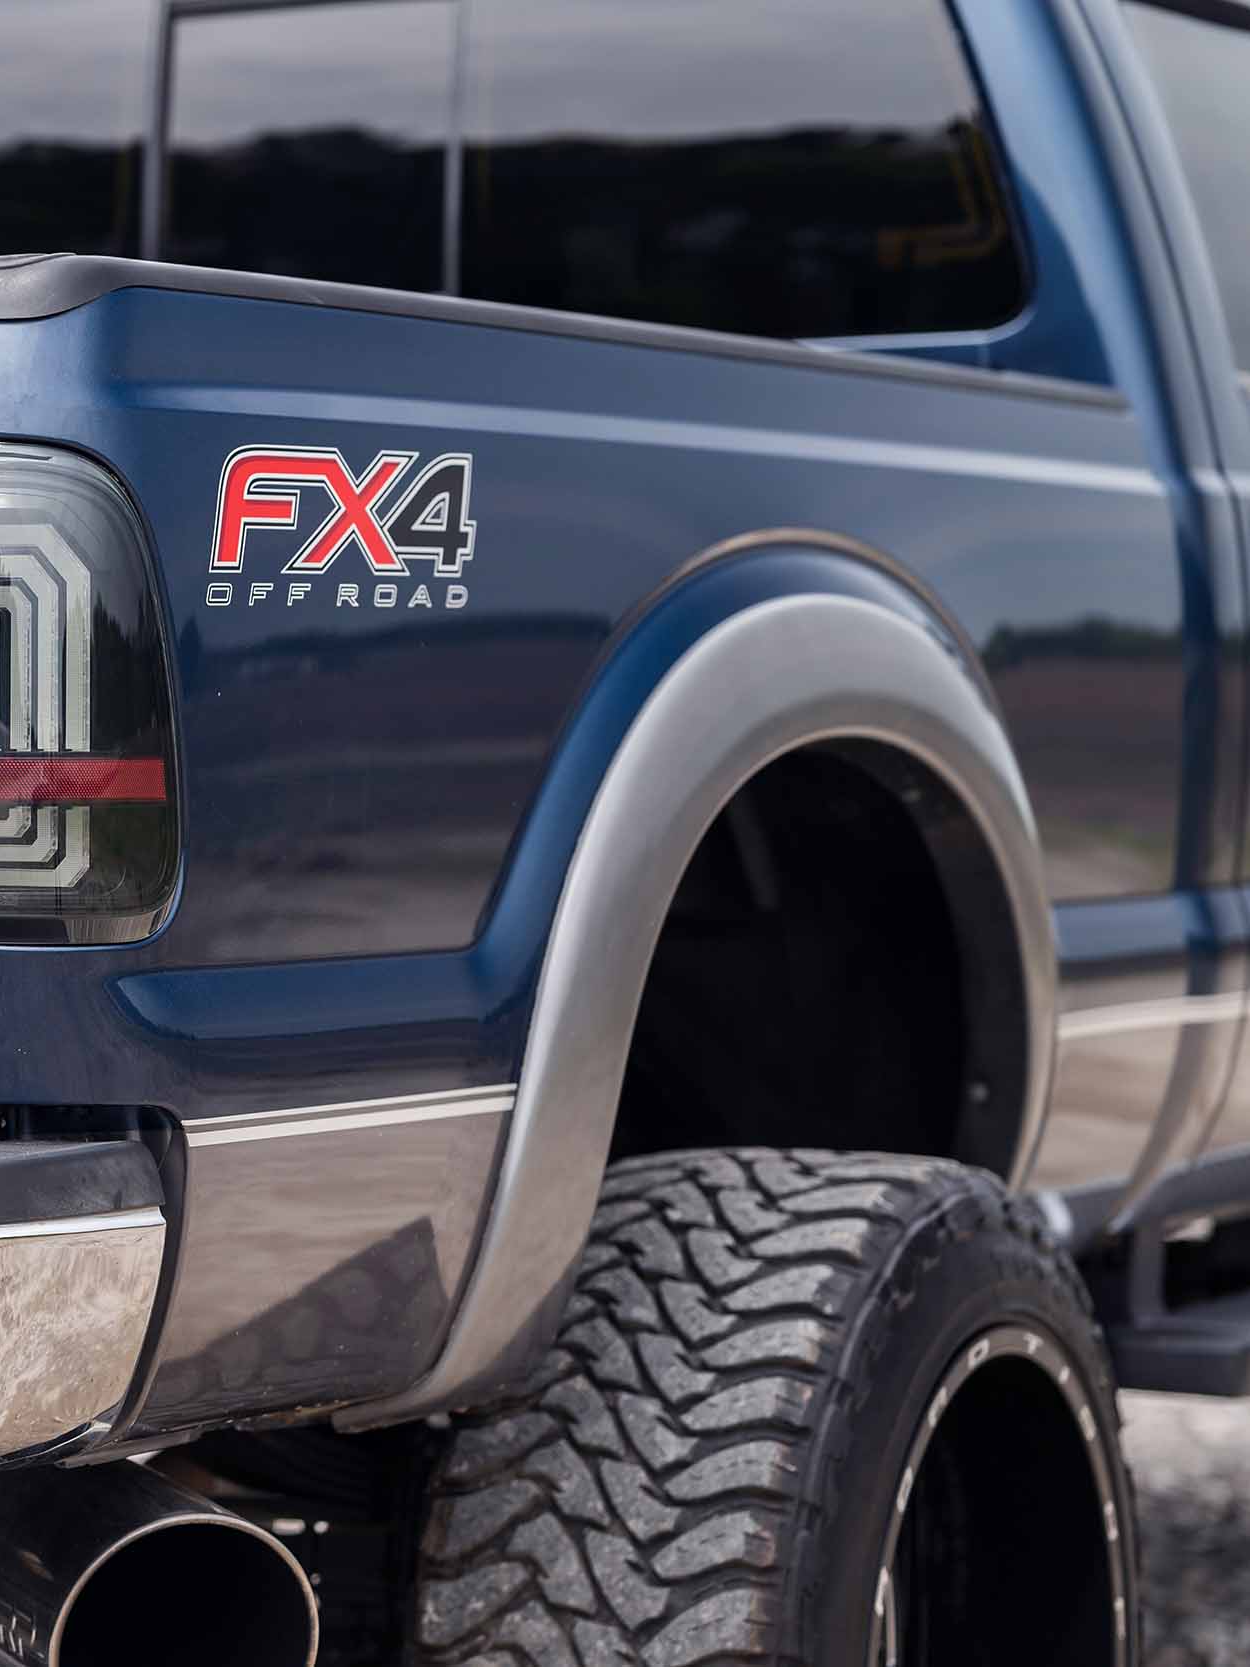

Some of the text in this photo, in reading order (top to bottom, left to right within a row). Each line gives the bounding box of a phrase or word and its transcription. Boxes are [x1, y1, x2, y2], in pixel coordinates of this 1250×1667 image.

[209, 444, 477, 578] FX4
[206, 582, 469, 609] OFF ROAD
